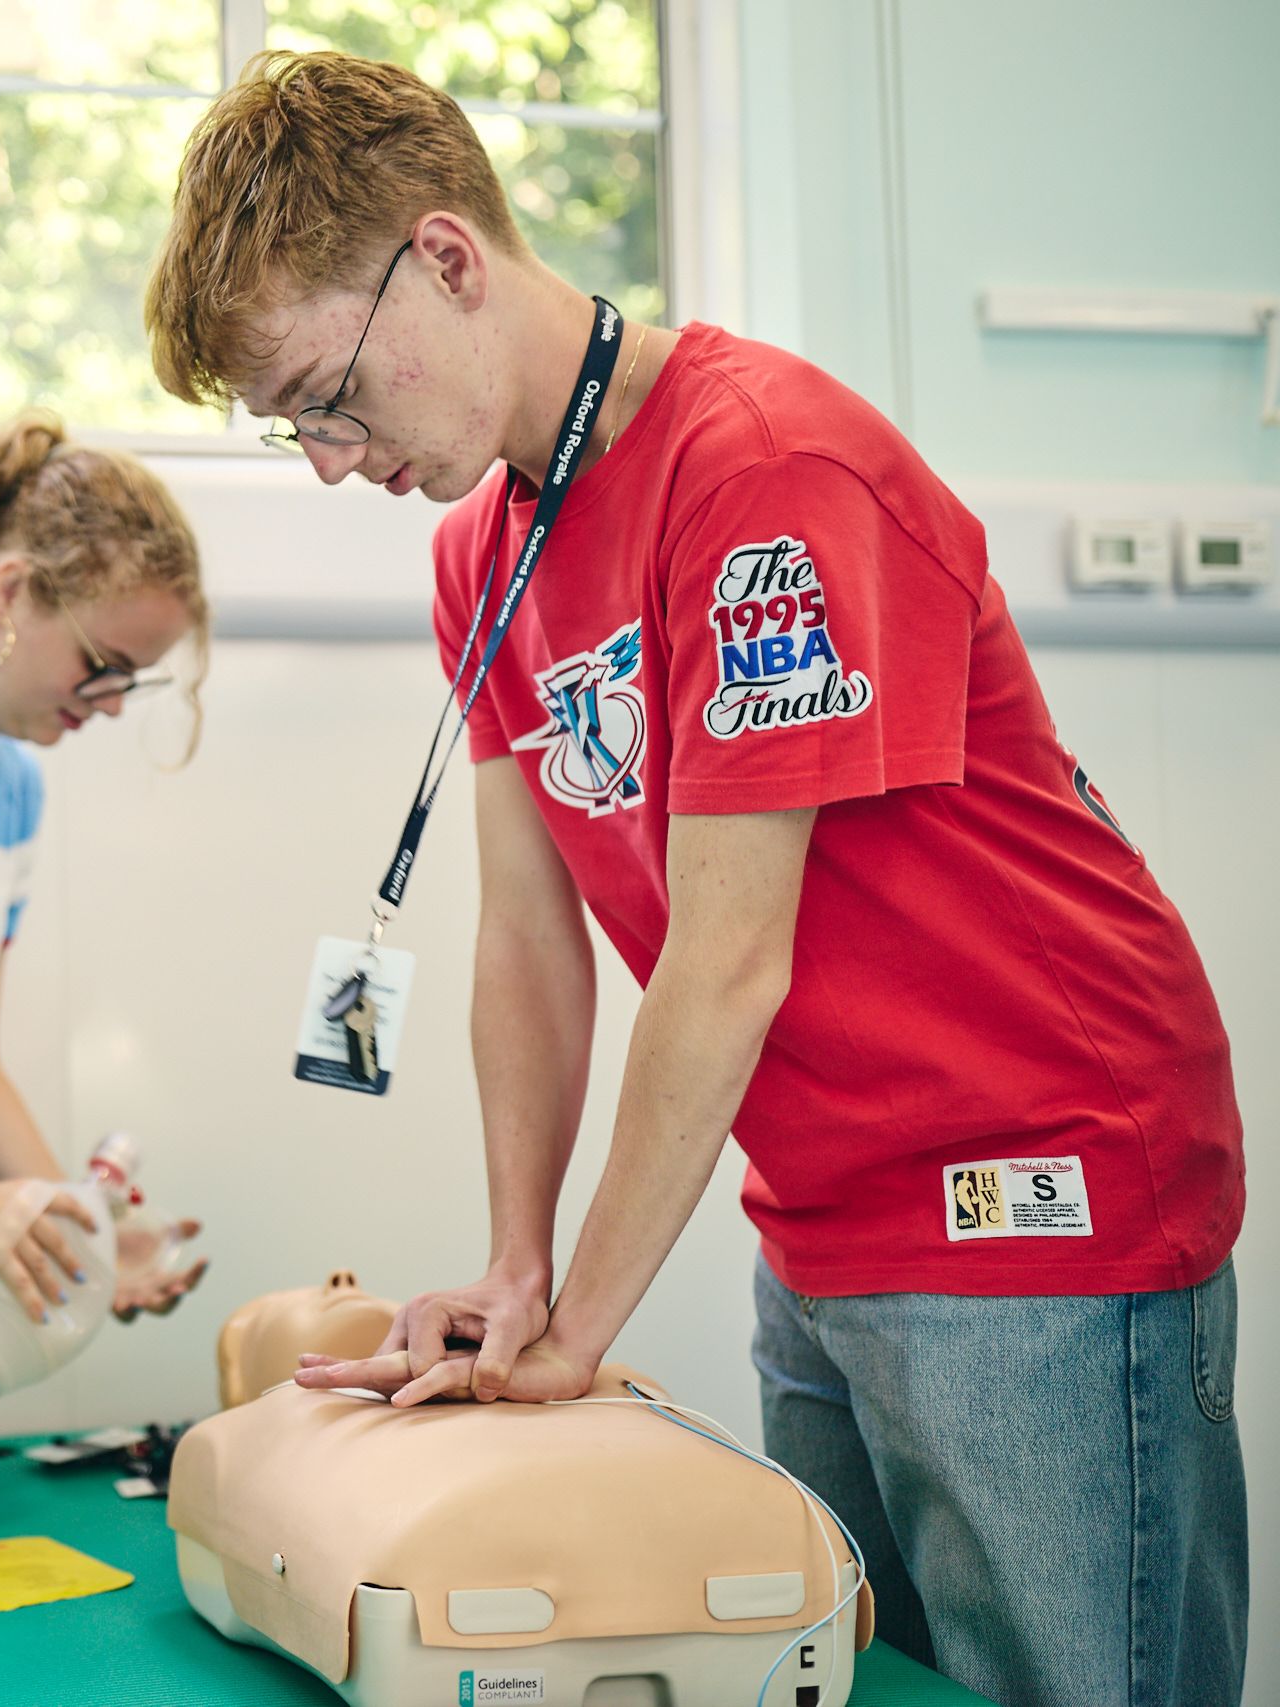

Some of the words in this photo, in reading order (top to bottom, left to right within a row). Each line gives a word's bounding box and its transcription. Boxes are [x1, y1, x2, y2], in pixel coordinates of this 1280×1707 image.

[571, 379, 601, 433] Oxford
[552, 432, 581, 486] Royale
[518, 525, 545, 576] Oxford
[718, 540, 812, 603] The
[497, 576, 524, 628] Royale
[713, 588, 826, 643] 1995
[722, 628, 838, 683] NBA
[707, 669, 867, 735] Finals
[388, 848, 414, 902] Oxford
[1008, 1161, 1043, 1171] Mitchell
[1051, 1161, 1074, 1172] Ness
[1032, 1173, 1057, 1202] S
[958, 1217, 975, 1227] NBA
[461, 1678, 471, 1702] 2015
[478, 1677, 538, 1690] Guidelines
[478, 1690, 537, 1701] COMPLIANT
